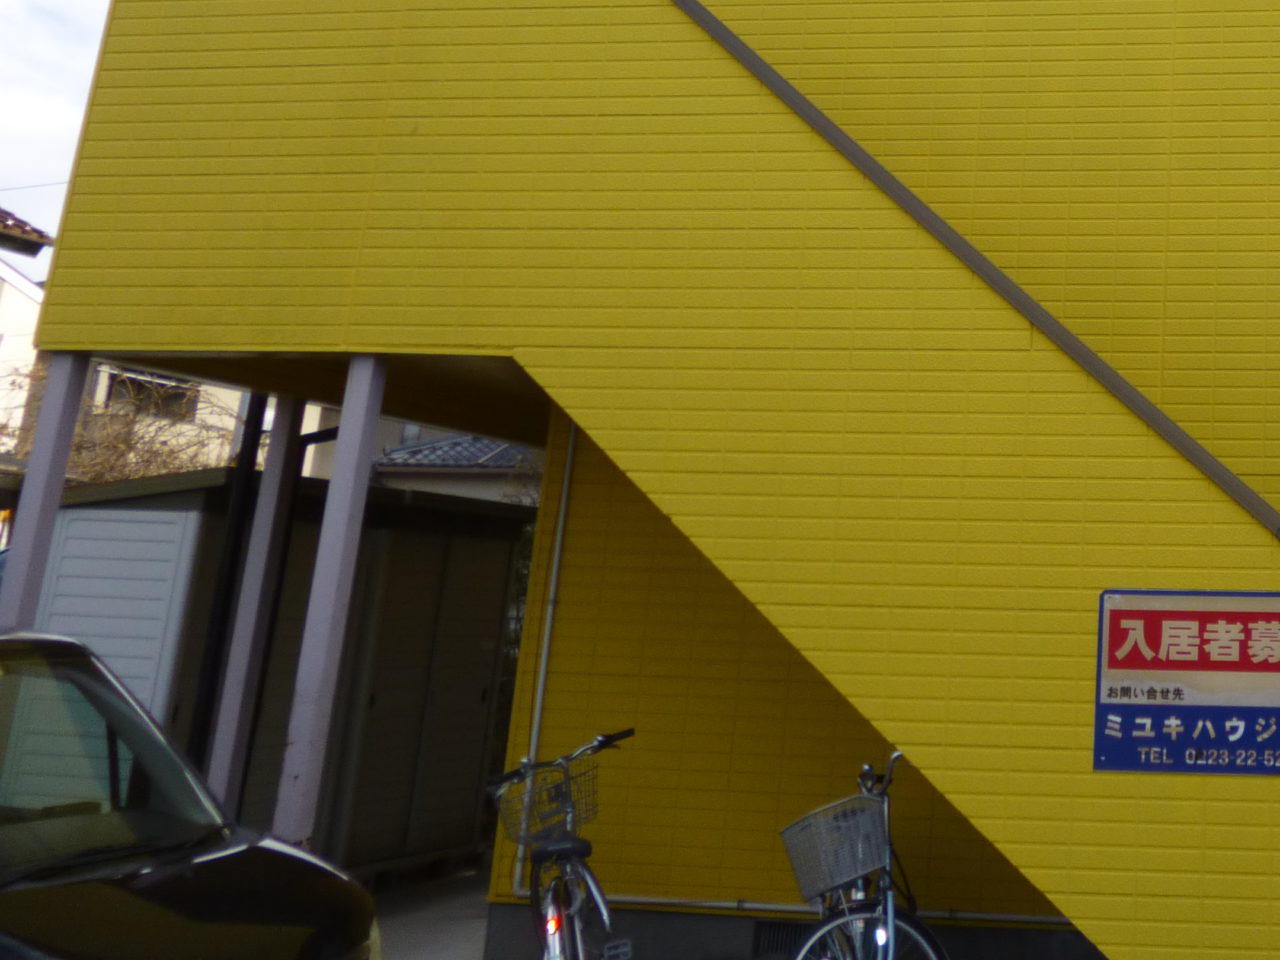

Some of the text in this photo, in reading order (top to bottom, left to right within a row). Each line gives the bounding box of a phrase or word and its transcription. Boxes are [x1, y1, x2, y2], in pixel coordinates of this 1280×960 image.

[1106, 686, 1185, 701] お問い合せ先
[1137, 747, 1174, 764] TEL
